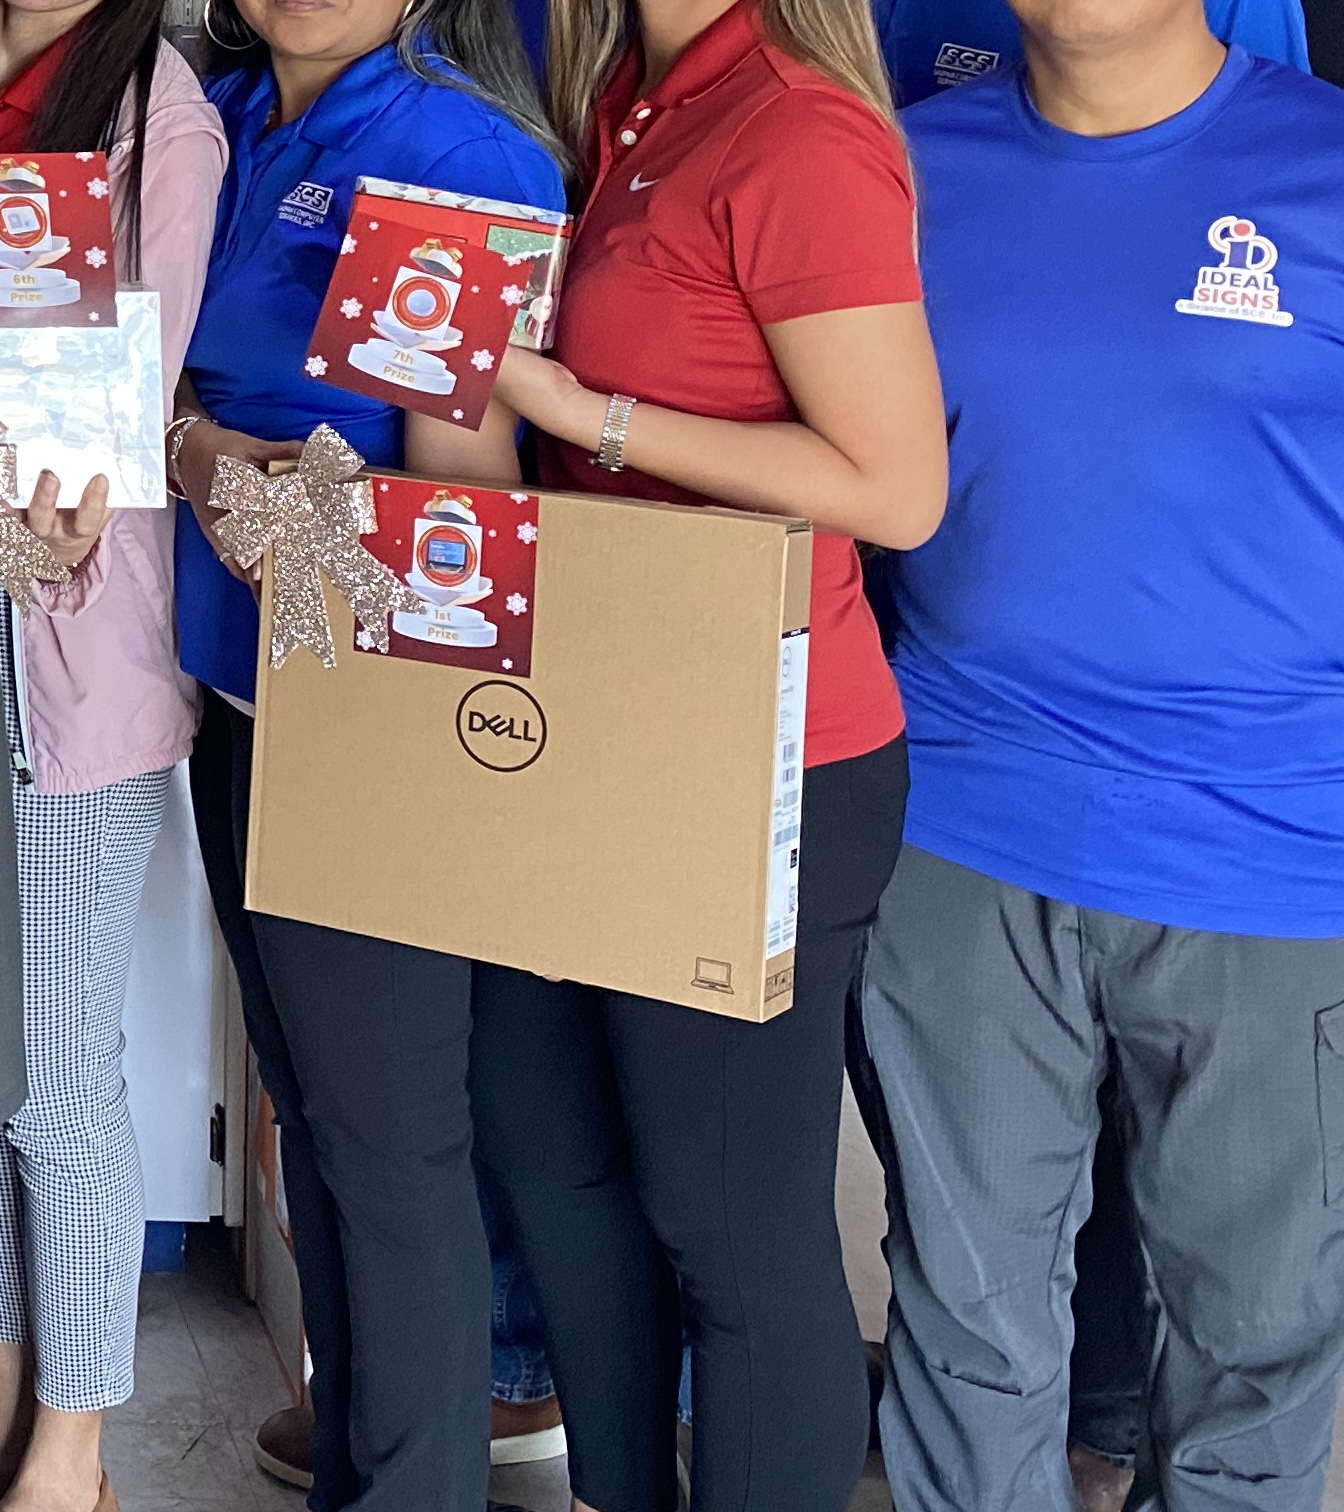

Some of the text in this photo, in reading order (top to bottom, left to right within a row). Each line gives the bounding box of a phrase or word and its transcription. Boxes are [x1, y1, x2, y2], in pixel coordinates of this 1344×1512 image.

[13, 274, 36, 285] 6th
[1201, 270, 1276, 292] IDEAL
[10, 292, 43, 303] Prize
[1196, 287, 1275, 311] SIGNS
[393, 349, 413, 364] 7th
[383, 365, 417, 383] Prize
[435, 610, 452, 622] 1st
[427, 626, 460, 641] Prize
[469, 711, 537, 743] DELL
